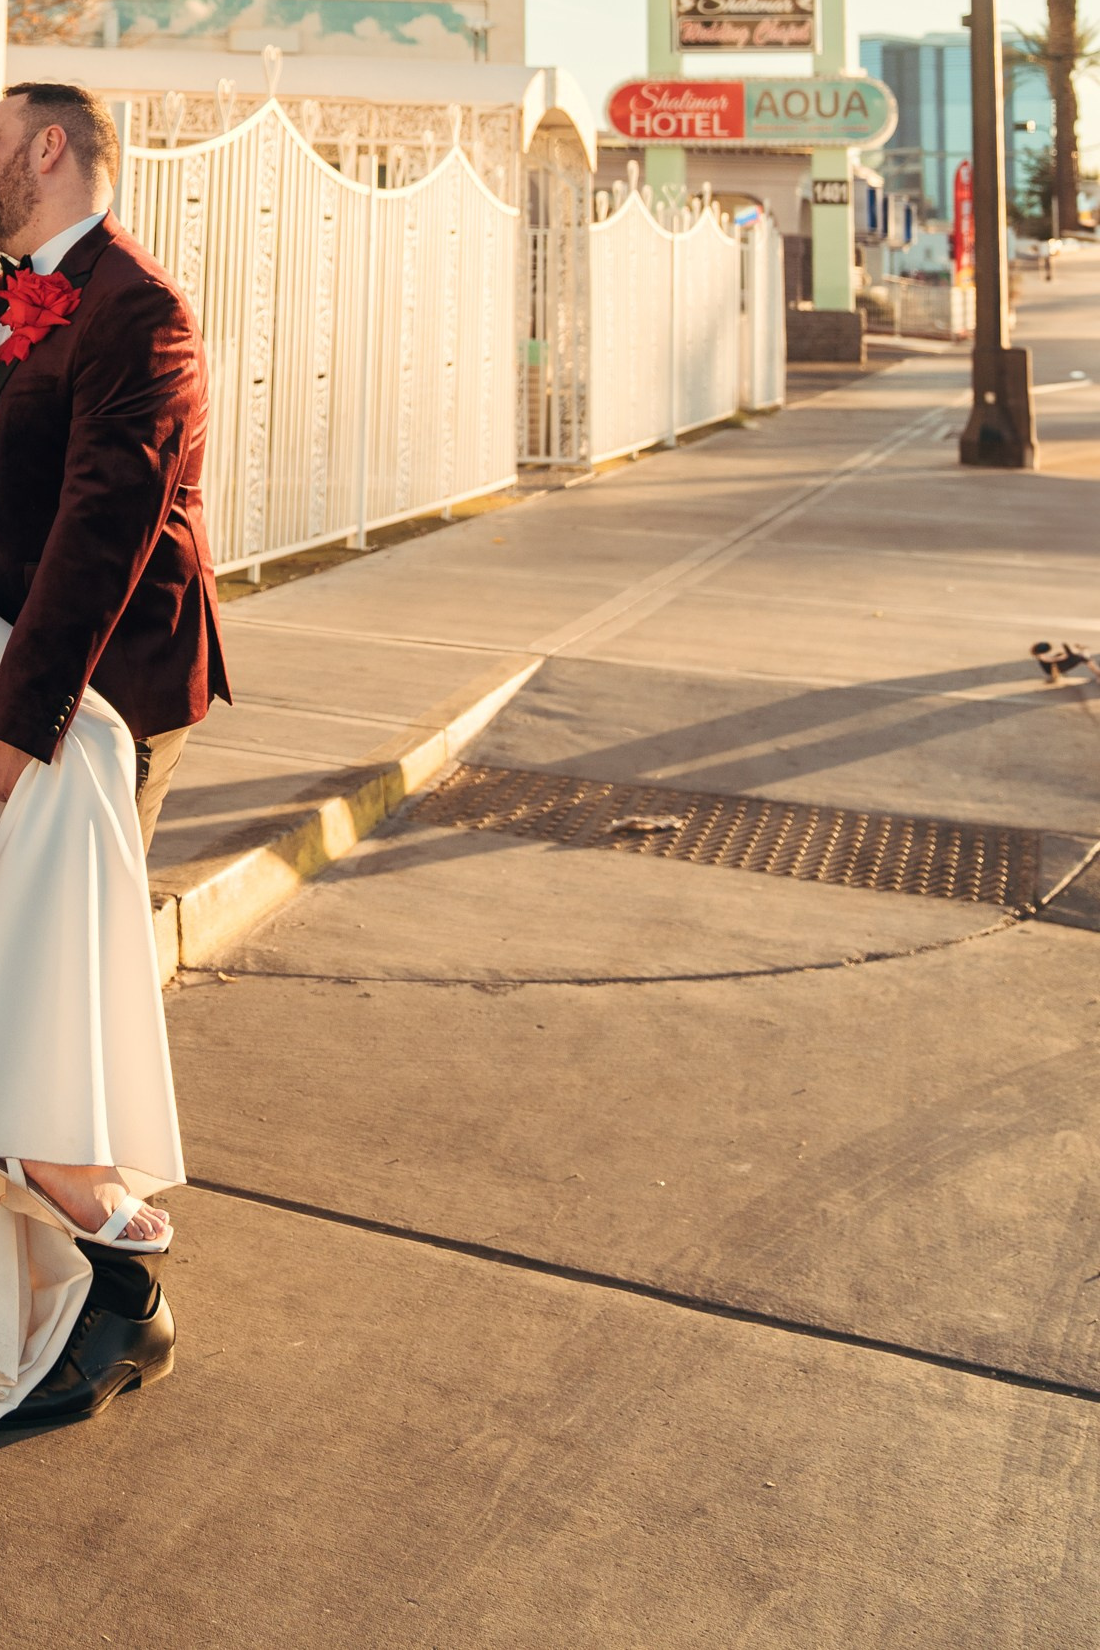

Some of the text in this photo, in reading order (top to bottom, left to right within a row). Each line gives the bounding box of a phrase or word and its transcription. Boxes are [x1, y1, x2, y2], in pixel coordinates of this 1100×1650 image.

[630, 82, 729, 113] Shalimar
[754, 88, 869, 122] AQUA
[630, 112, 729, 137] HOTEL
[814, 182, 847, 203] 1401
